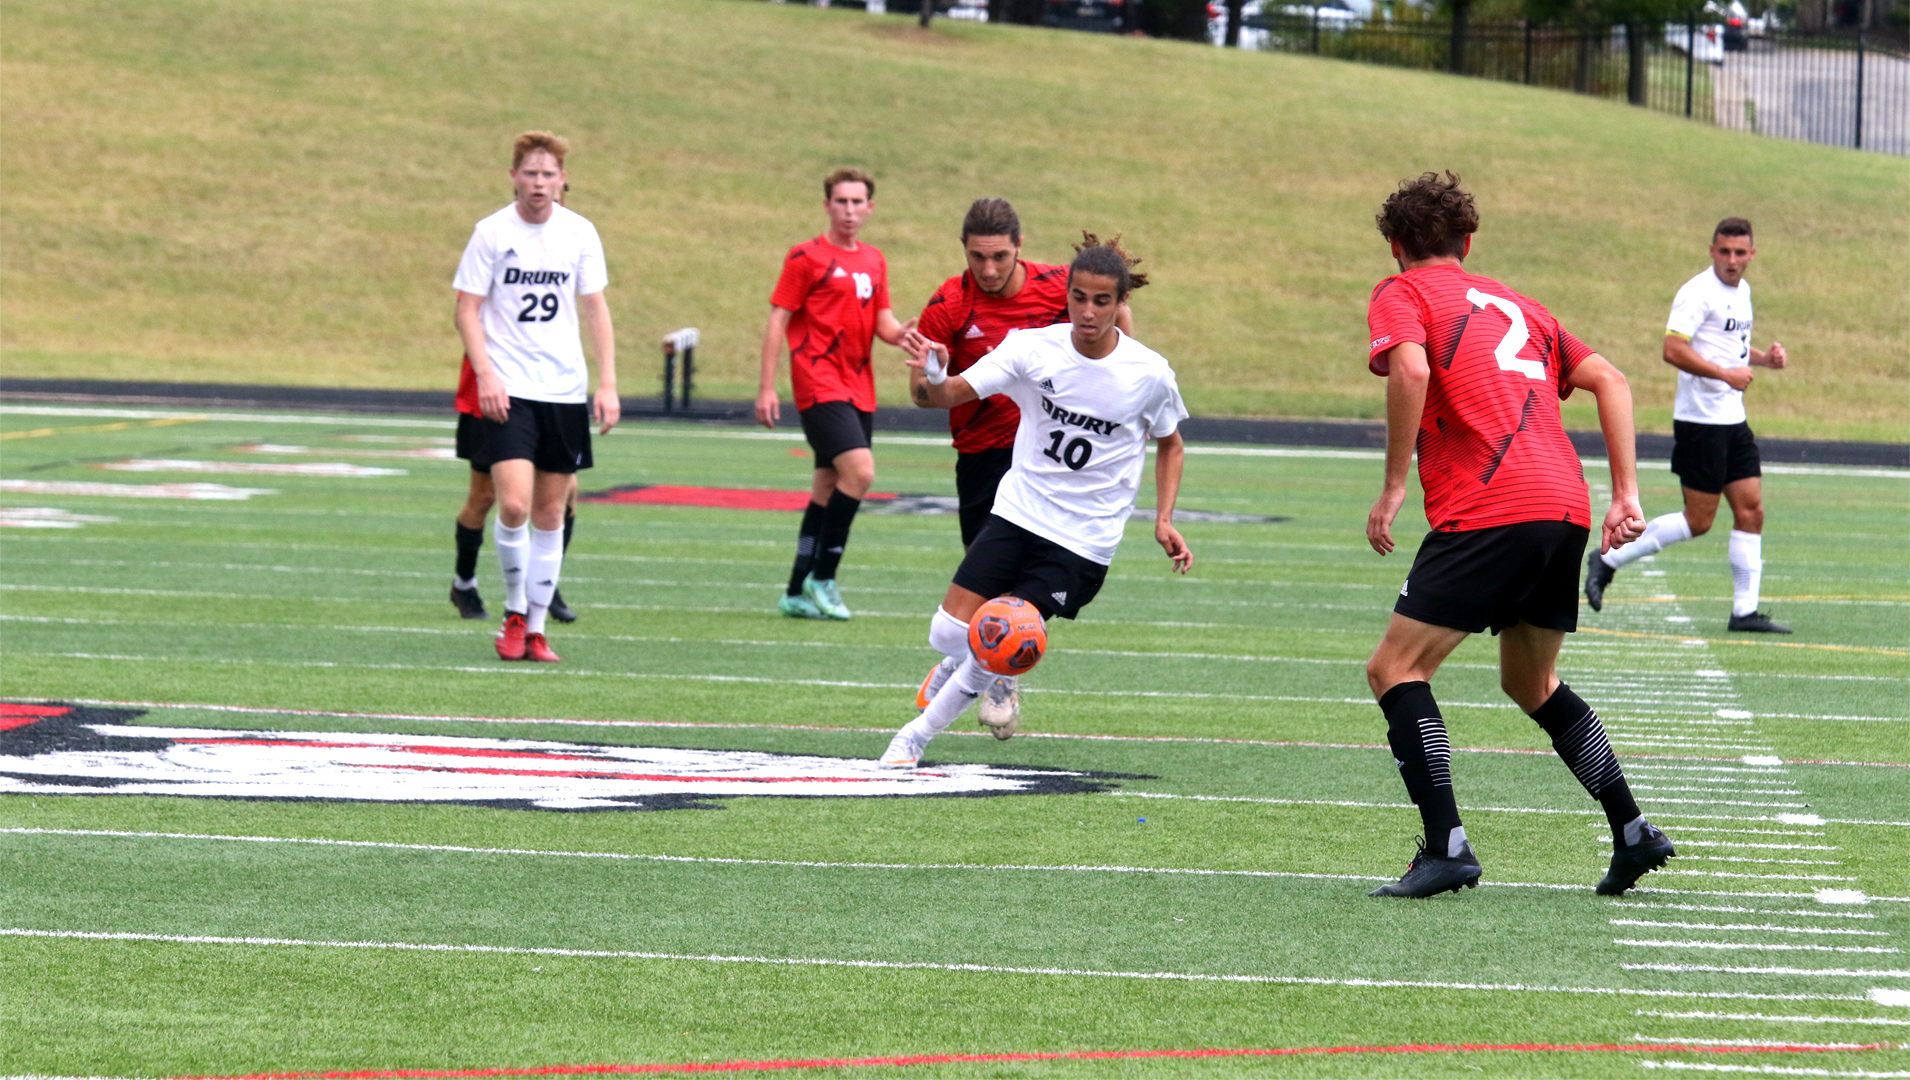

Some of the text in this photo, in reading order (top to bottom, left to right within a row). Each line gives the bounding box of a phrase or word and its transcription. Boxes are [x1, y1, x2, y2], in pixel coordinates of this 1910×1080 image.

[503, 267, 570, 286] DRURY
[517, 293, 559, 322] 29
[1466, 287, 1546, 381] 2
[1041, 394, 1121, 436] DRURY
[1043, 429, 1093, 471] 10
